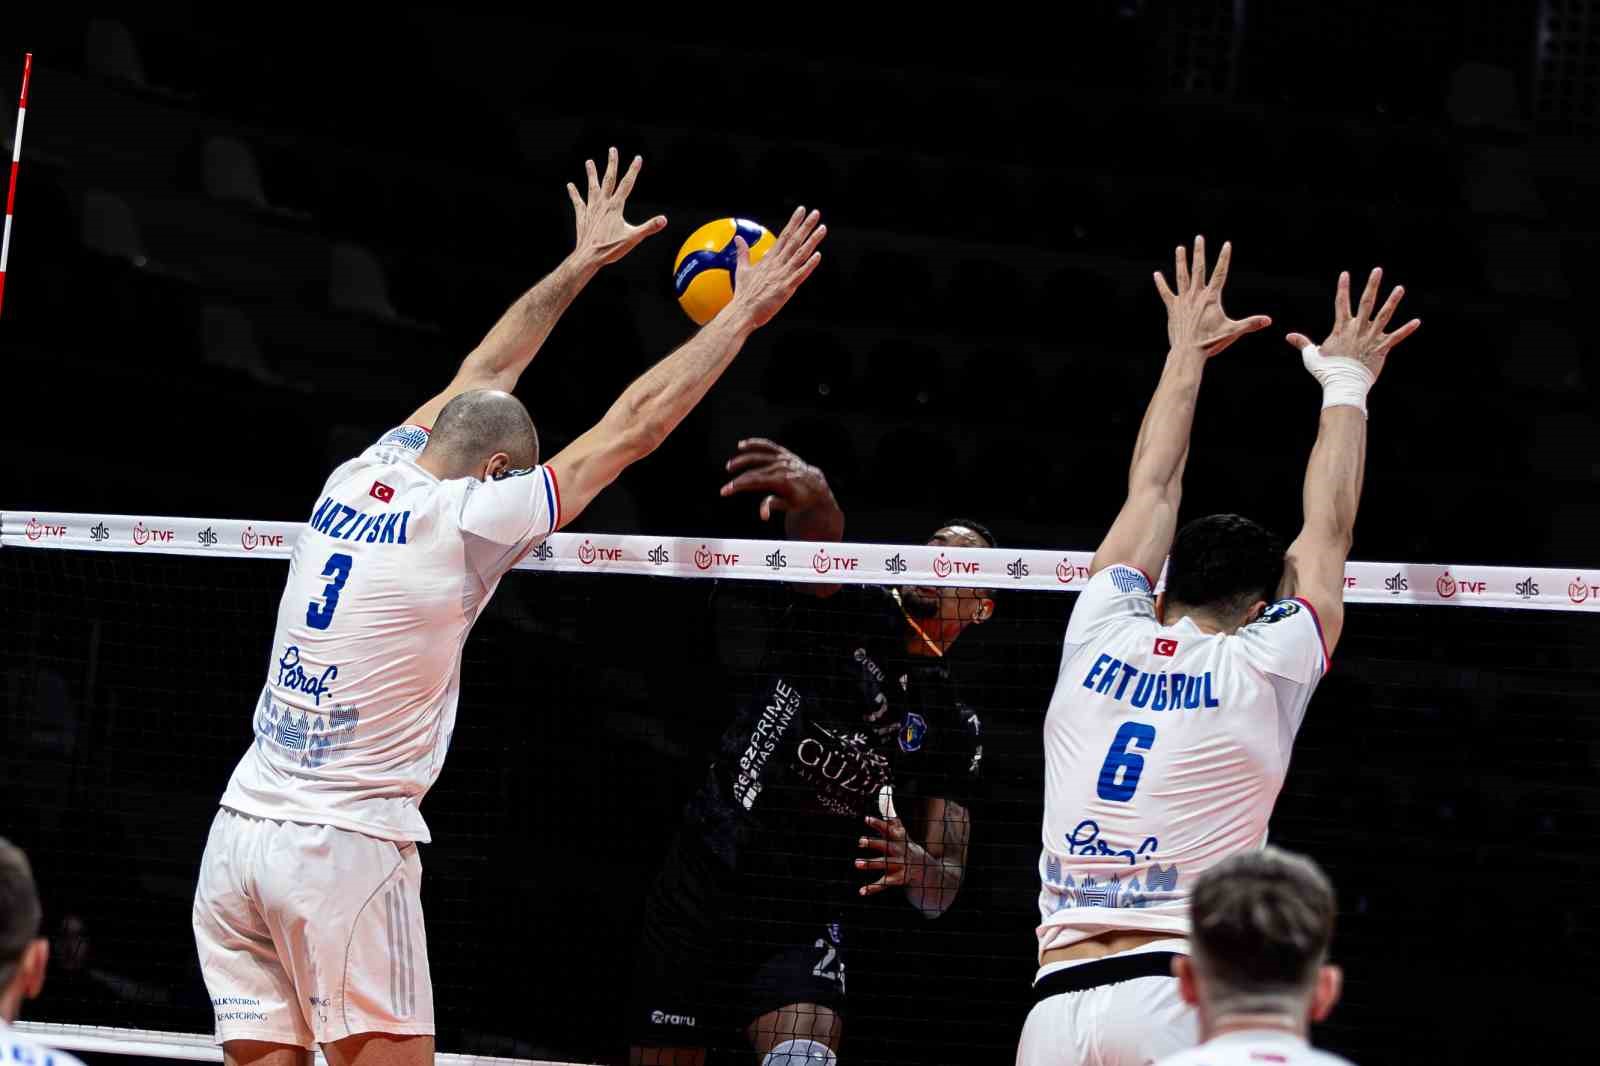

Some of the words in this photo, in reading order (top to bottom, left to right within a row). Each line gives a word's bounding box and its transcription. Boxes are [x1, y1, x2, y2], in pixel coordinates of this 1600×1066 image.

[44, 526, 66, 537] TVF
[151, 530, 174, 542] TVF
[261, 535, 283, 546] TVF
[599, 548, 622, 560] TVF
[715, 553, 739, 566] TVF
[833, 558, 858, 570] TVF
[953, 562, 980, 574] TVF
[1459, 581, 1486, 593] TVF
[306, 553, 352, 630] 3
[1096, 721, 1156, 802] 6
